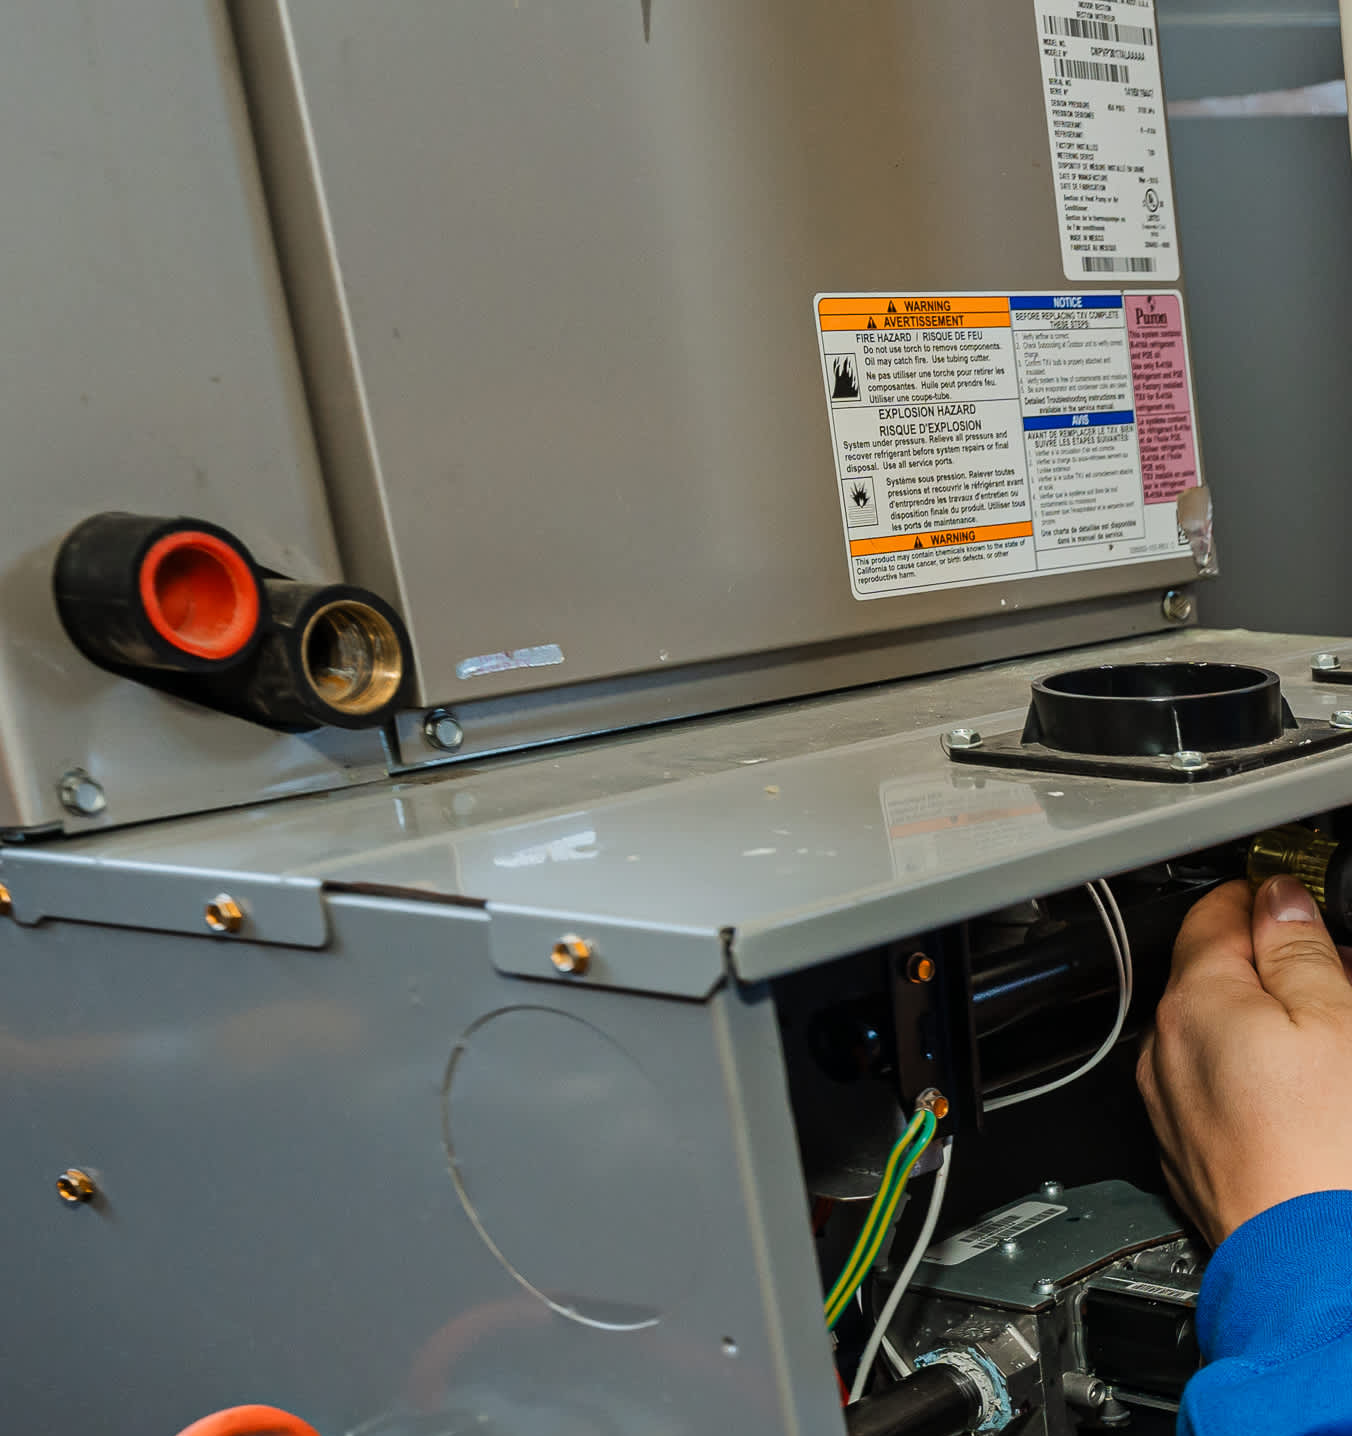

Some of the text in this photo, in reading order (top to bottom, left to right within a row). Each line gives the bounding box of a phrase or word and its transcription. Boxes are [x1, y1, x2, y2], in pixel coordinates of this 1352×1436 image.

[904, 301, 951, 312] WARNING
[1053, 298, 1083, 308] NOTICE
[884, 315, 965, 327] AVERTISSEMENT
[856, 333, 875, 343] FIRE
[877, 333, 912, 342] HAZARD
[922, 332, 952, 341] RISQUE
[955, 332, 965, 340] DE
[968, 331, 983, 340] FEU
[863, 346, 873, 354] Do
[876, 346, 887, 354] not
[904, 345, 921, 353] torch
[924, 344, 931, 352] to
[865, 358, 875, 366] Oil
[877, 359, 891, 367] may
[894, 356, 913, 365] catch
[915, 356, 928, 364] fire.
[932, 355, 945, 364] Use
[947, 355, 969, 365] tubing
[866, 372, 876, 380] Ne
[878, 373, 891, 381] pas
[893, 370, 917, 379] utiliser
[933, 369, 955, 377] torche
[957, 370, 972, 378] pour
[996, 367, 1005, 375] les
[921, 381, 938, 390] Huile
[940, 381, 955, 390] peut
[957, 380, 983, 389] prendre
[985, 379, 996, 387] feu.
[870, 395, 895, 403] Utiliser
[879, 404, 976, 419] EXPLOSION HAZARD
[1071, 415, 1090, 425] AVIS
[880, 420, 982, 437] RISQUE D'EXPLOSION
[843, 440, 870, 451] System
[872, 438, 893, 447] under
[929, 434, 954, 443] Relieve
[965, 433, 992, 442] pressure
[992, 431, 1007, 439] and
[874, 449, 911, 461] refrigerant
[913, 447, 934, 456] before
[936, 446, 960, 456] system
[962, 444, 985, 454] repairs
[995, 441, 1009, 450] final
[846, 463, 879, 474] disposal.
[883, 462, 896, 470] Use
[909, 459, 933, 468] service
[995, 468, 1015, 476] toutes
[888, 488, 922, 499] pressions
[923, 486, 930, 494] et
[932, 483, 962, 493] recouvrir
[1006, 478, 1024, 486] avant
[937, 496, 947, 504] les
[949, 493, 973, 503] travaux
[891, 509, 929, 521] disposition
[930, 507, 949, 516] finale
[951, 506, 959, 514] du
[988, 500, 1010, 510] Utiliser
[1012, 499, 1026, 507] tous
[892, 524, 902, 532] les
[904, 522, 922, 532] ports
[923, 520, 932, 528] de
[931, 531, 976, 545] WARNING
[856, 558, 869, 566] This
[871, 555, 895, 565] product
[897, 555, 910, 563] may
[912, 550, 934, 559] contain
[935, 547, 965, 556] chemicals
[966, 544, 985, 552] known
[1004, 540, 1018, 548] state
[857, 565, 887, 575] California
[947, 556, 960, 564] birth
[994, 550, 1009, 558] other
[858, 570, 916, 586] reproductive harm.
